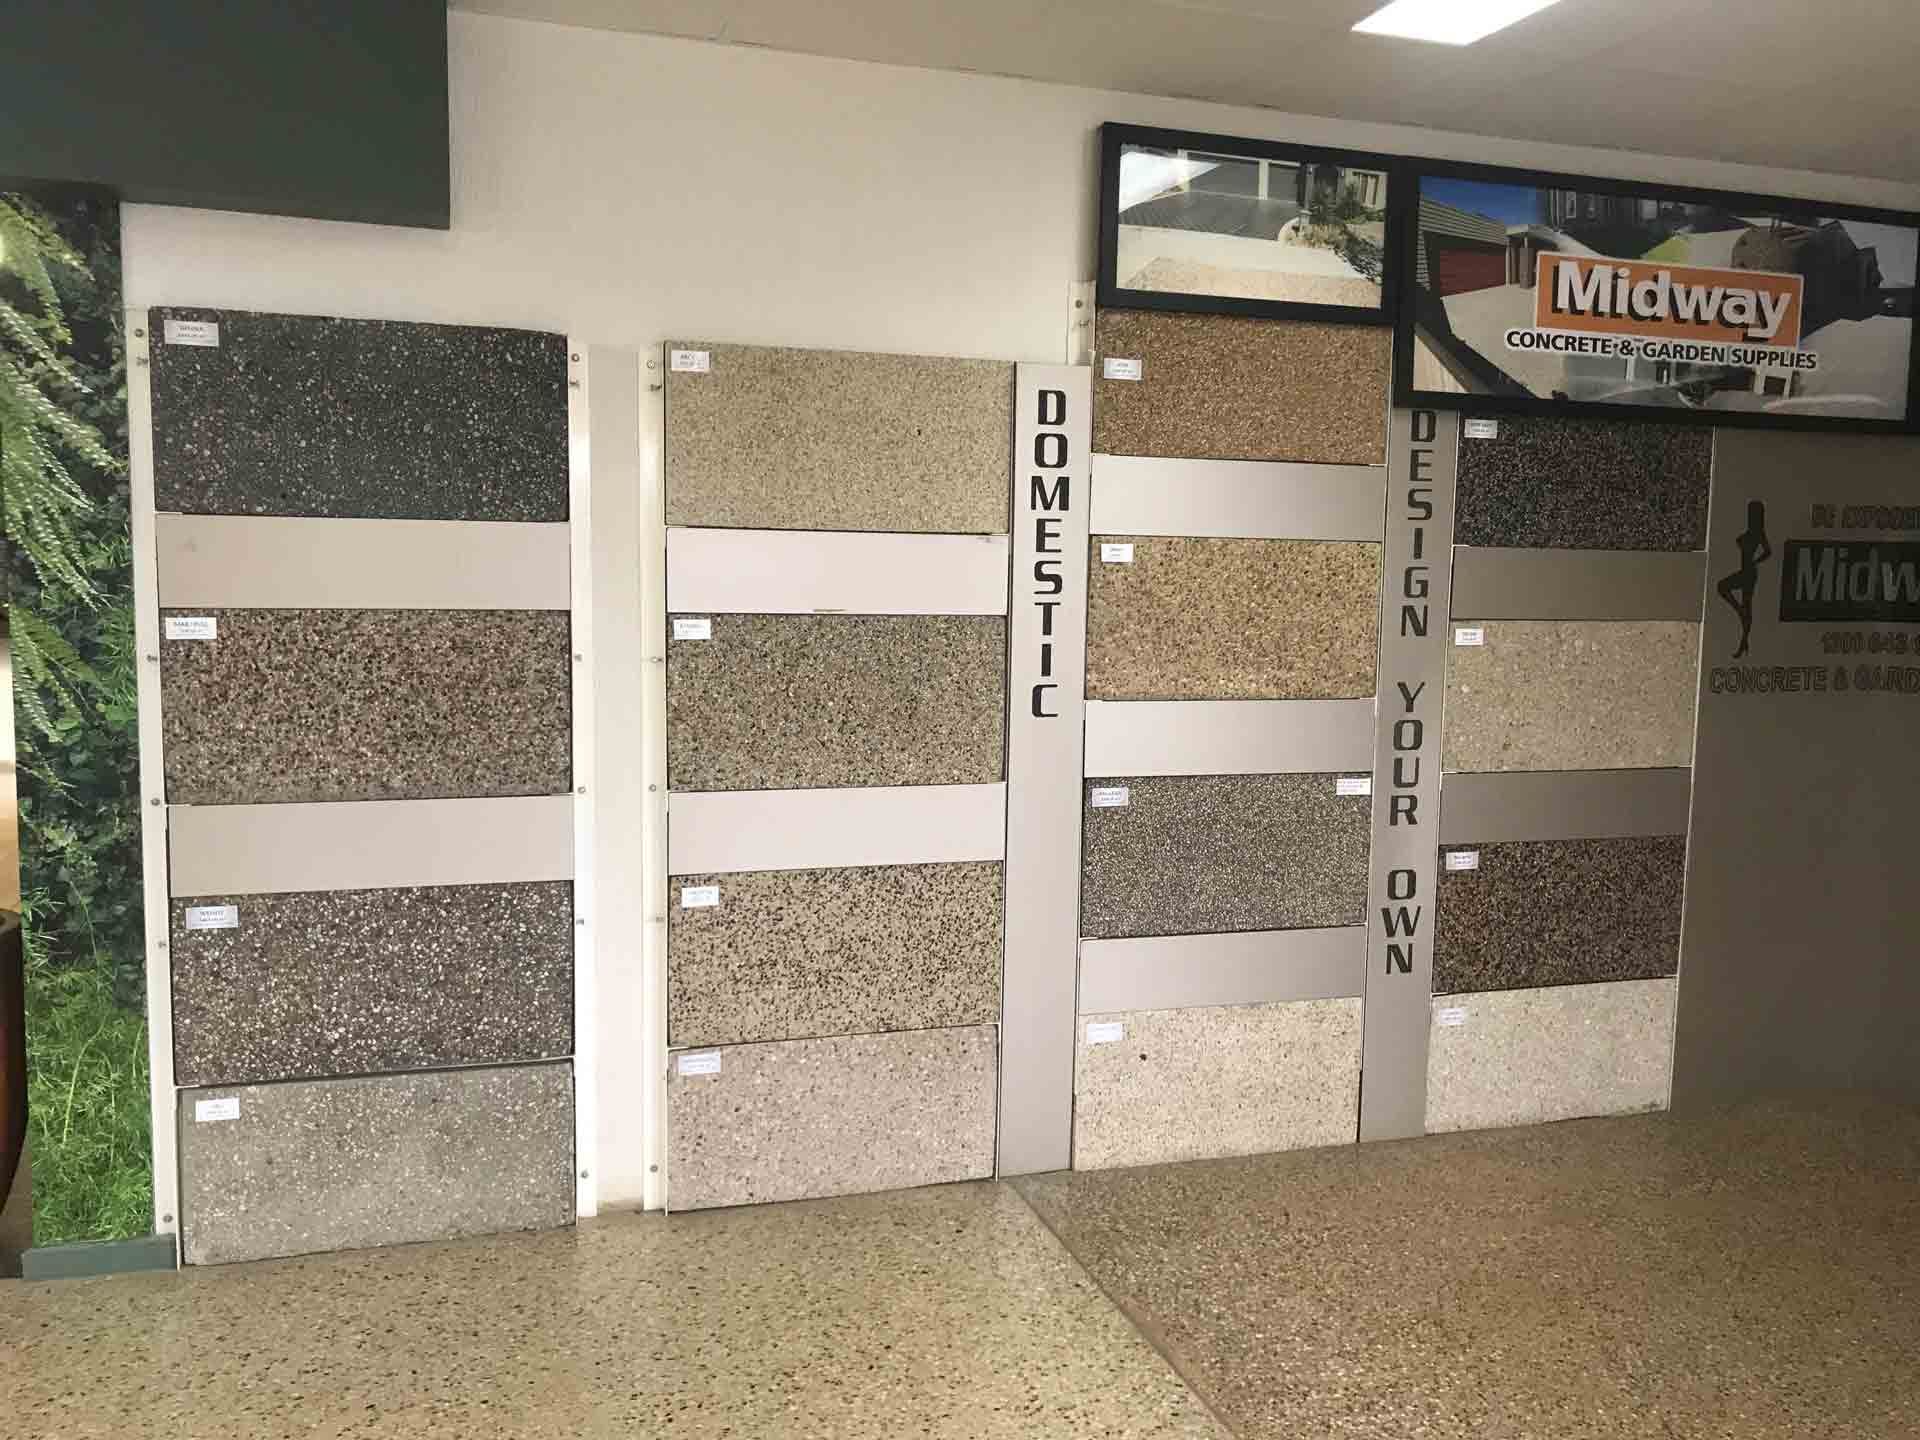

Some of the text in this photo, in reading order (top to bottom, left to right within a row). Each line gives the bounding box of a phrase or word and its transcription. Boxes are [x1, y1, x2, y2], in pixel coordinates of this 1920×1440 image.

[1553, 260, 1793, 341] Midway
[1505, 330, 1818, 370] CONCRETE & GARDEN SUPPLIES
[1030, 389, 1071, 718] DOMESTIC
[1381, 410, 1437, 975] DESIGN YOUR OWN
[1711, 665, 1826, 694] CONCRETE
